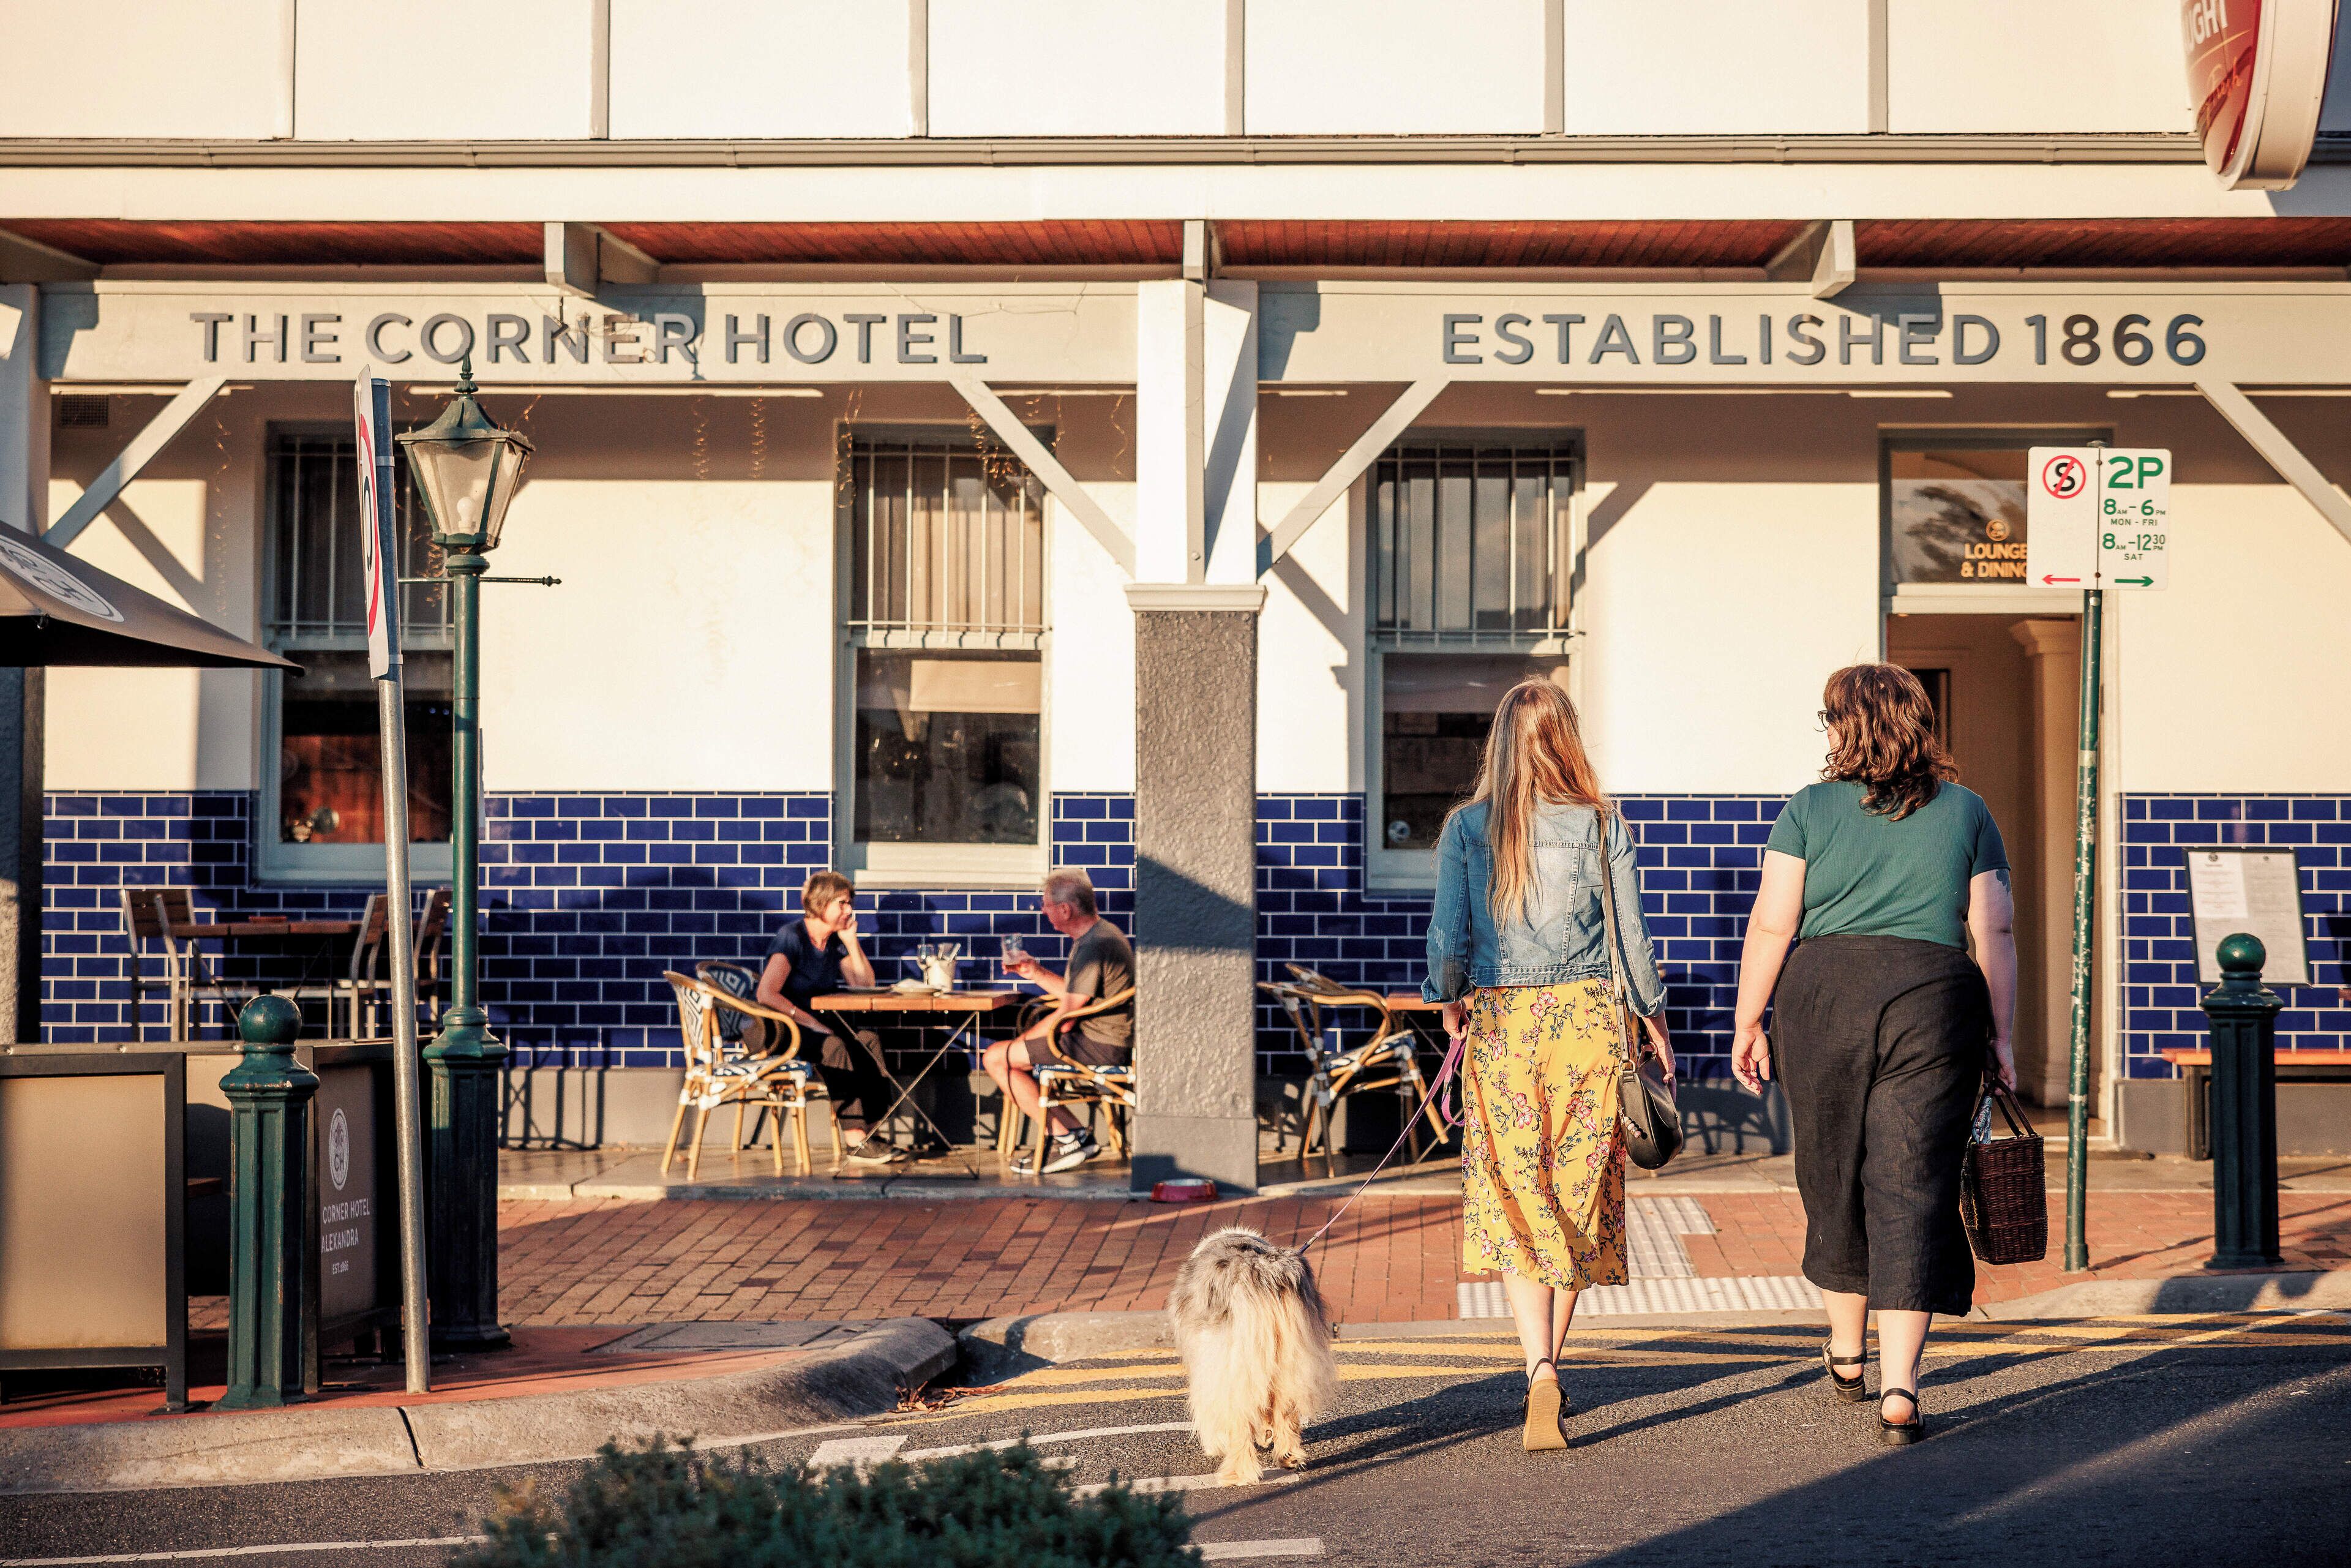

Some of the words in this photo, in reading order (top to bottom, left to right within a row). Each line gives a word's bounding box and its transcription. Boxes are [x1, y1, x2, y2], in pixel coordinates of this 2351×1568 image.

[190, 313, 342, 362] THE
[366, 312, 698, 364] CORNER
[725, 312, 987, 364] HOTEL
[1442, 312, 2001, 366] ESTABLISHED
[2024, 313, 2207, 366] 1866
[2108, 456, 2164, 489] 2P
[1964, 542, 2027, 560] LOUNGE
[1960, 561, 1974, 578] &
[323, 1202, 349, 1224] CORNER
[350, 1198, 370, 1218] HOTEL
[321, 1228, 359, 1254] ALEXANDRA
